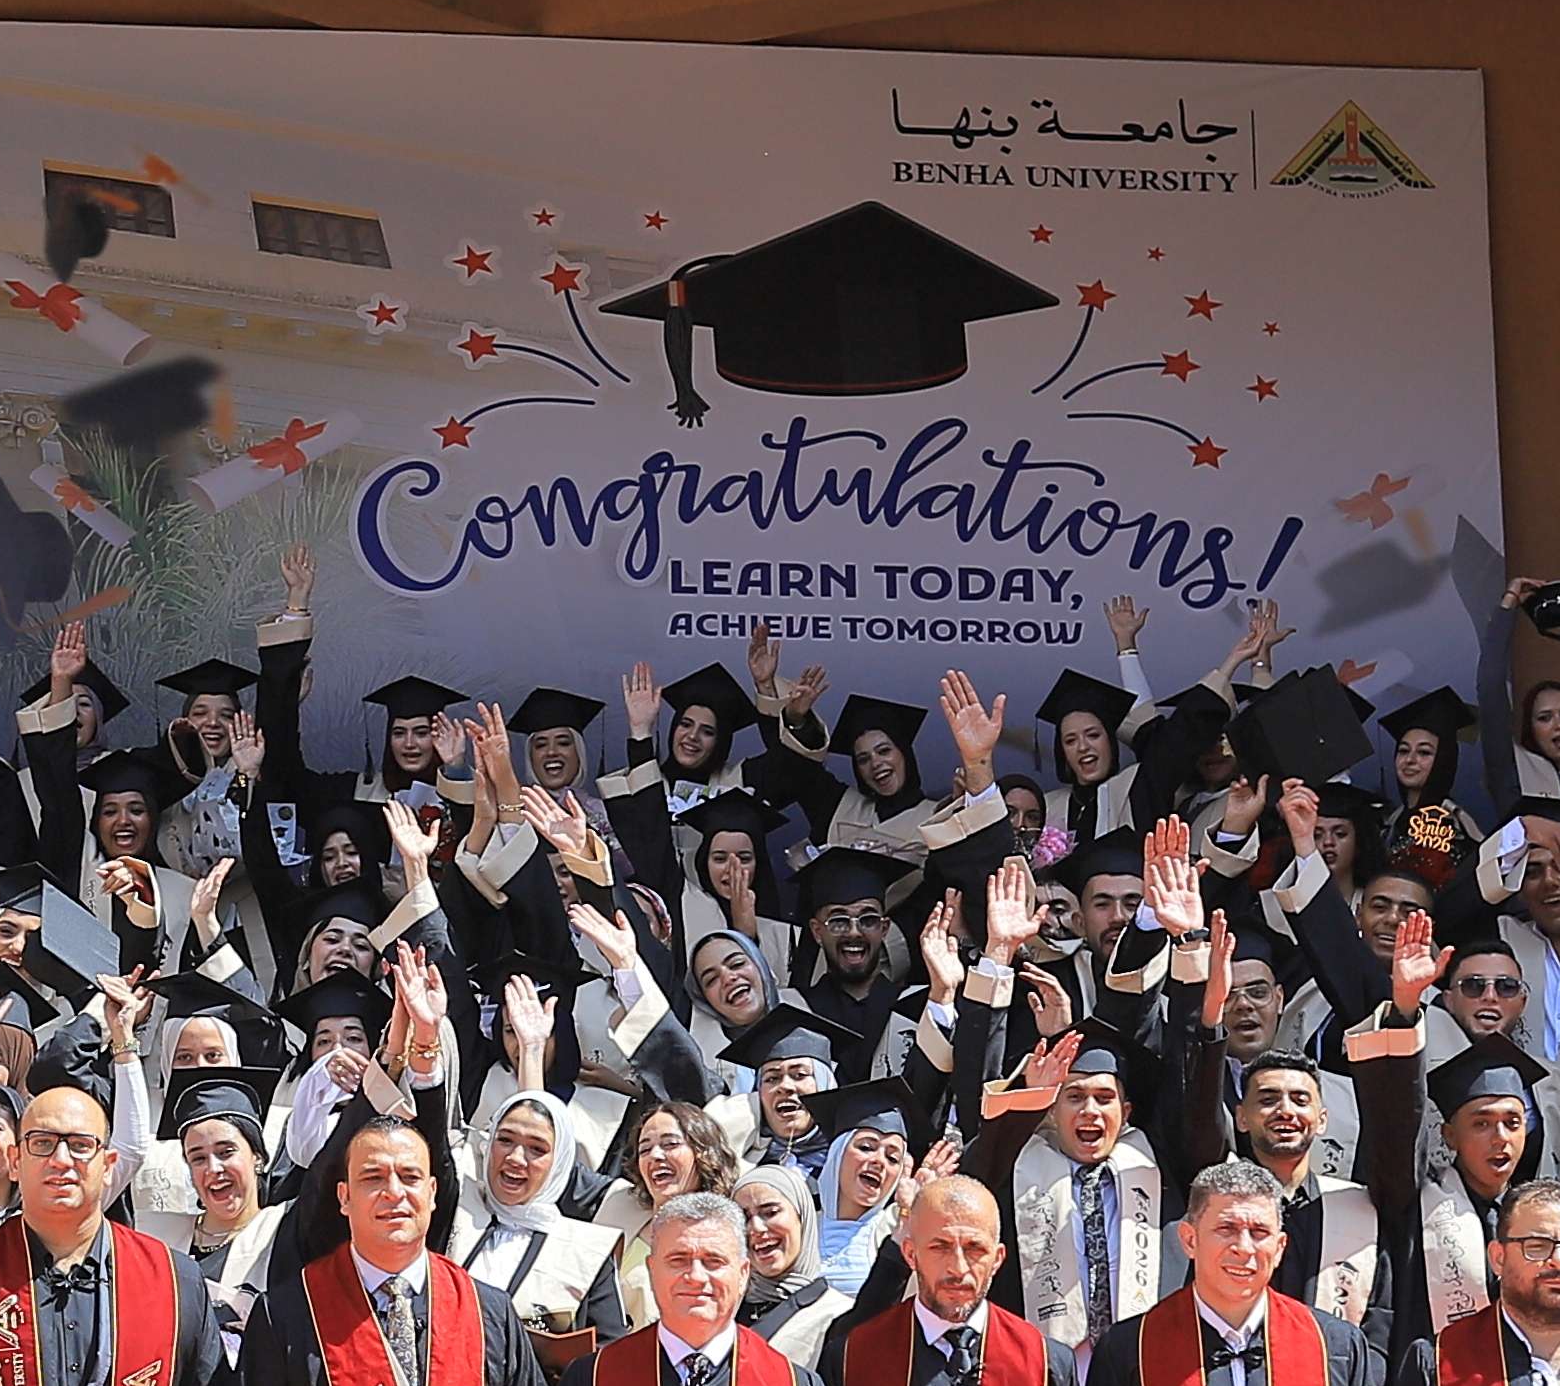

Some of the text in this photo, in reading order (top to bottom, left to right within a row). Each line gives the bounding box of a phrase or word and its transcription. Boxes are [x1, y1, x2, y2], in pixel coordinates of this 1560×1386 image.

[891, 88, 1238, 163] جامعة بنها
[893, 162, 1240, 193] BENHA UNIVERSITY
[356, 414, 1304, 609] Congratulations!
[670, 561, 1083, 615] LEARN TODAY,
[669, 612, 1083, 646] ACHIEVE TOMORROW
[1134, 1212, 1149, 1288] 2026
